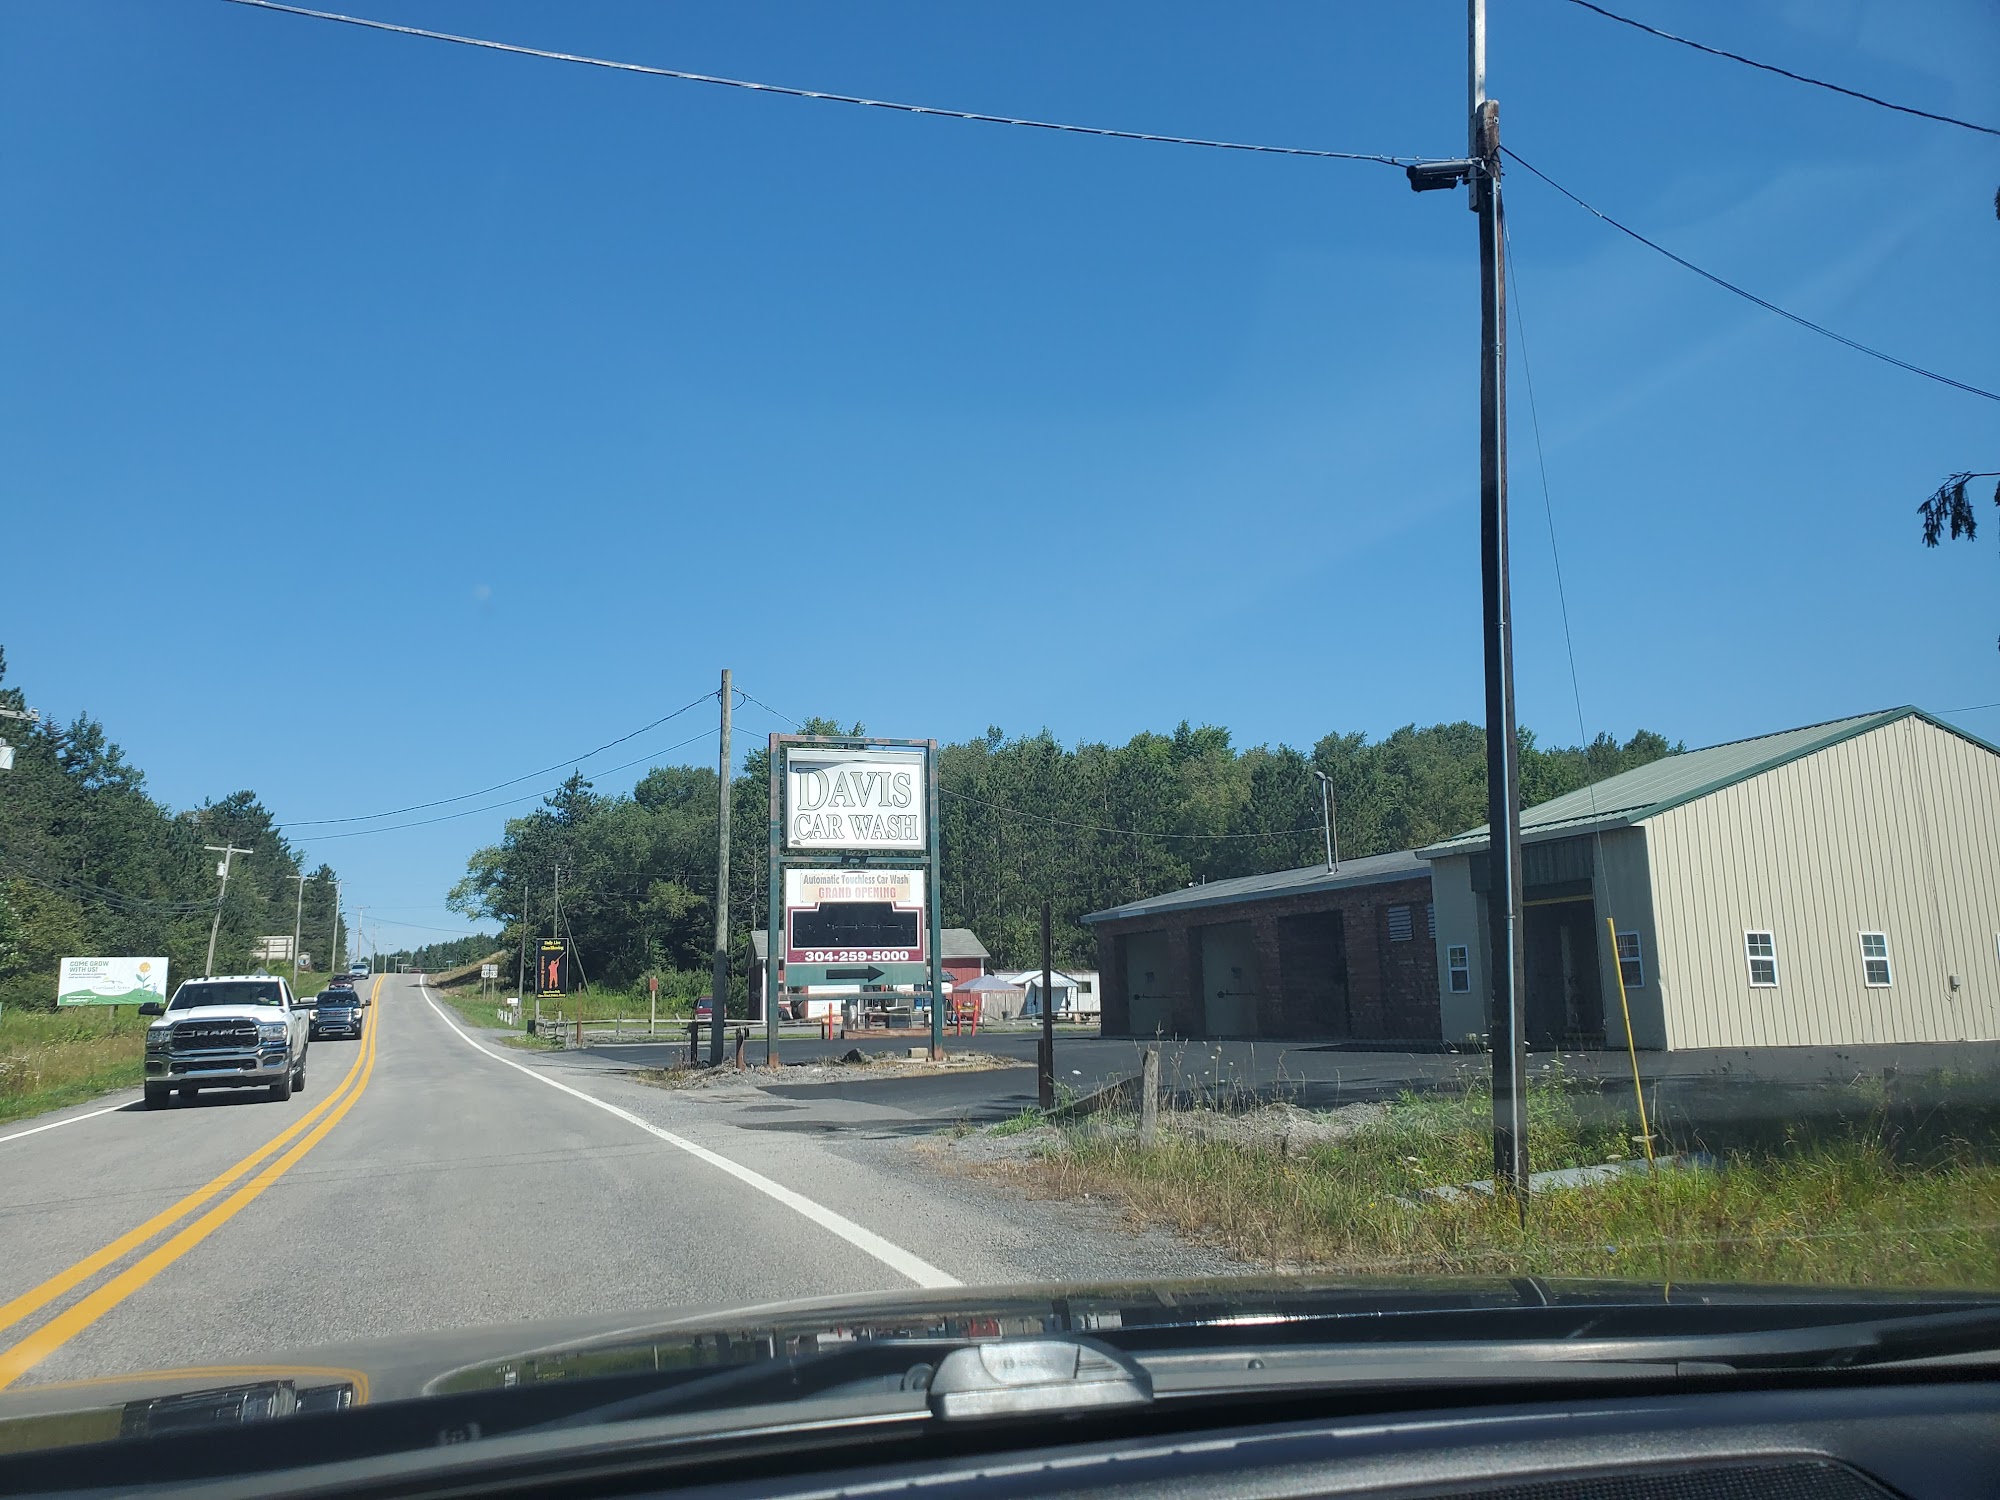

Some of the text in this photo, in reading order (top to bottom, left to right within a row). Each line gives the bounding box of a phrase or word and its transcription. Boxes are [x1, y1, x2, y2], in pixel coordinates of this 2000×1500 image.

[796, 767, 912, 811] DAVIS
[794, 814, 918, 840] CAR WASH
[803, 874, 909, 885] Automatic Touchless Car Wash
[818, 887, 896, 898] GRAND OPENING
[804, 951, 909, 962] 304-259-5000
